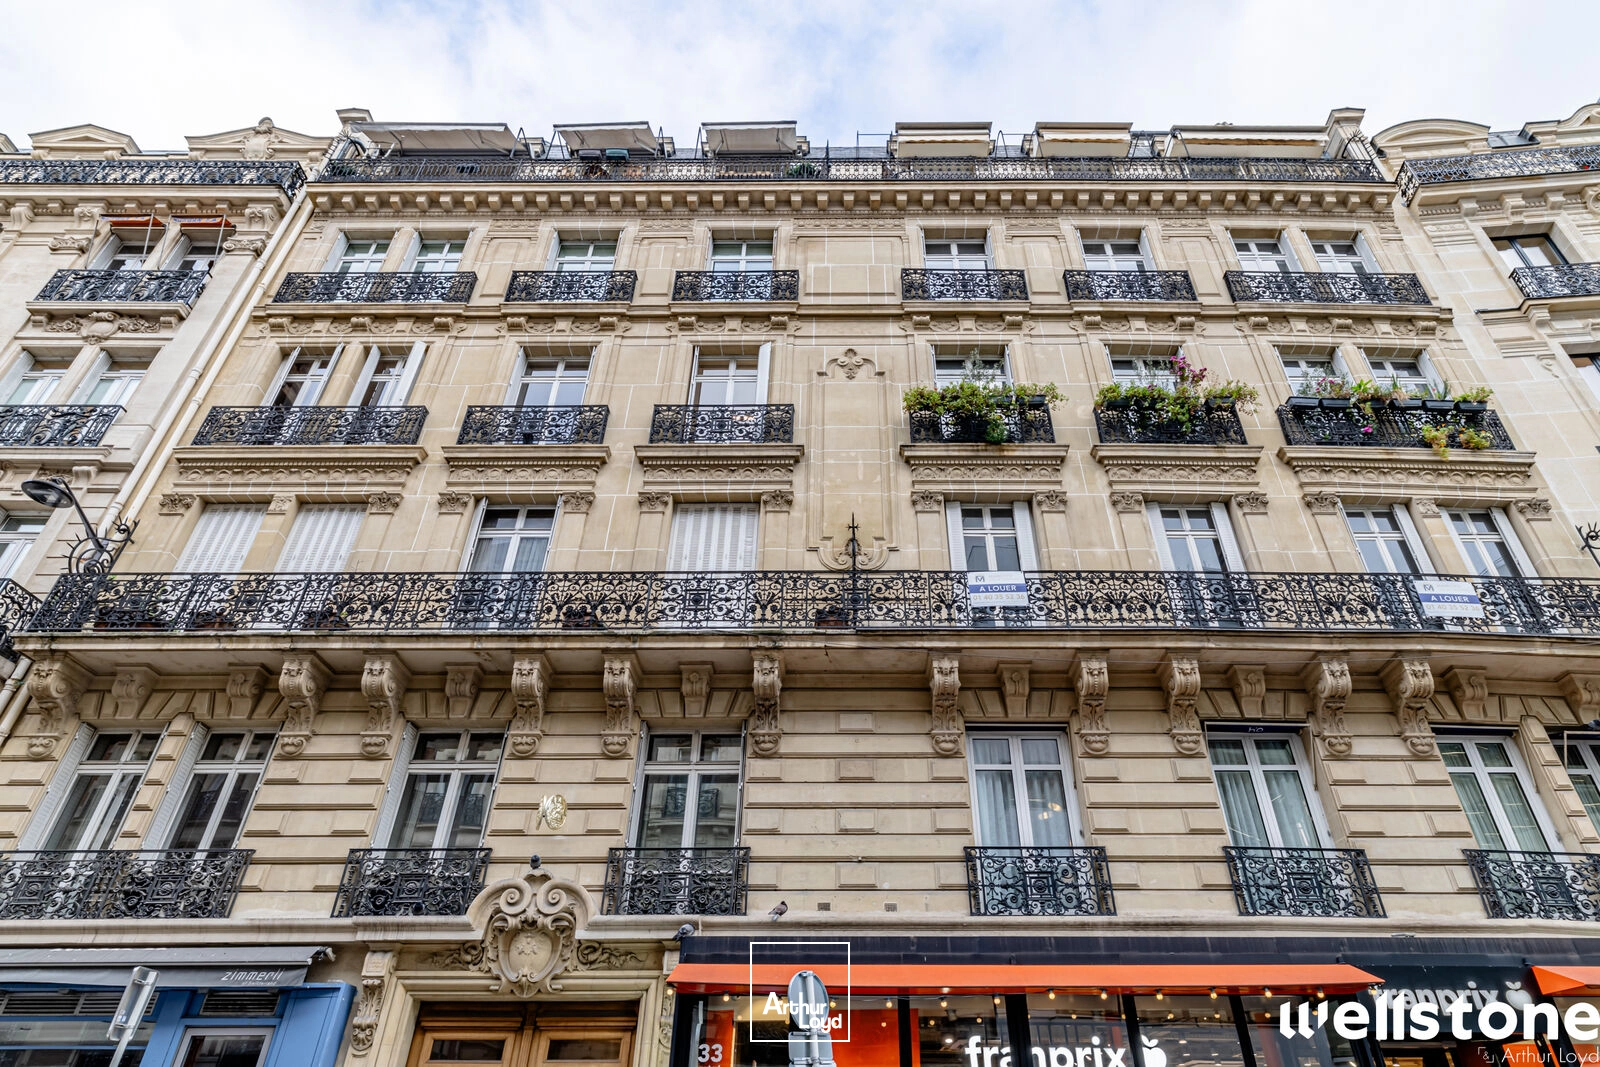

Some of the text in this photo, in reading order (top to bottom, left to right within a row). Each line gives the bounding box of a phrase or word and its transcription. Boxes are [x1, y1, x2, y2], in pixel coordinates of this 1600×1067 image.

[1439, 595, 1470, 603] LOUER
[221, 968, 284, 981] zimmerli
[697, 1043, 723, 1063] 33
